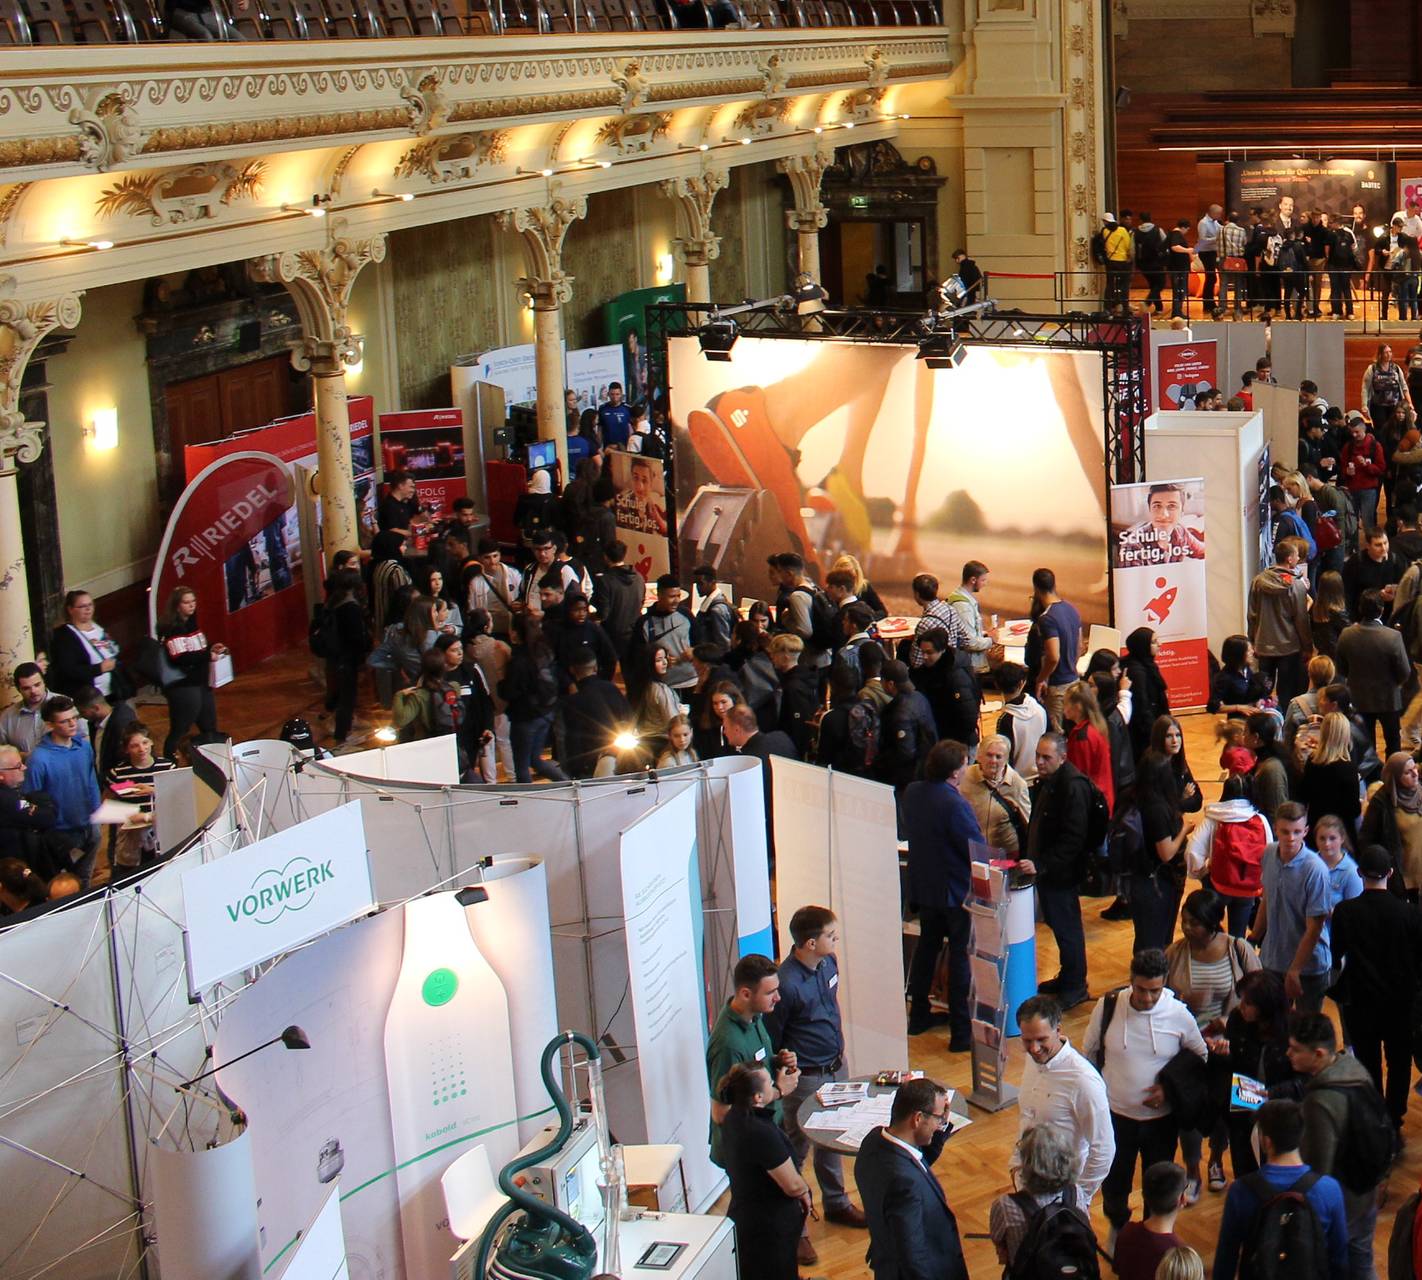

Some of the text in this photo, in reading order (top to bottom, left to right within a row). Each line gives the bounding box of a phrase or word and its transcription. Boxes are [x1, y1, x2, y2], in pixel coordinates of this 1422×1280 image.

[202, 484, 278, 546] RIEDEL
[1118, 528, 1171, 545] Schule,
[1119, 543, 1194, 562] fertig, los.
[226, 859, 334, 922] VORWERK
[425, 1121, 457, 1140] kobold
